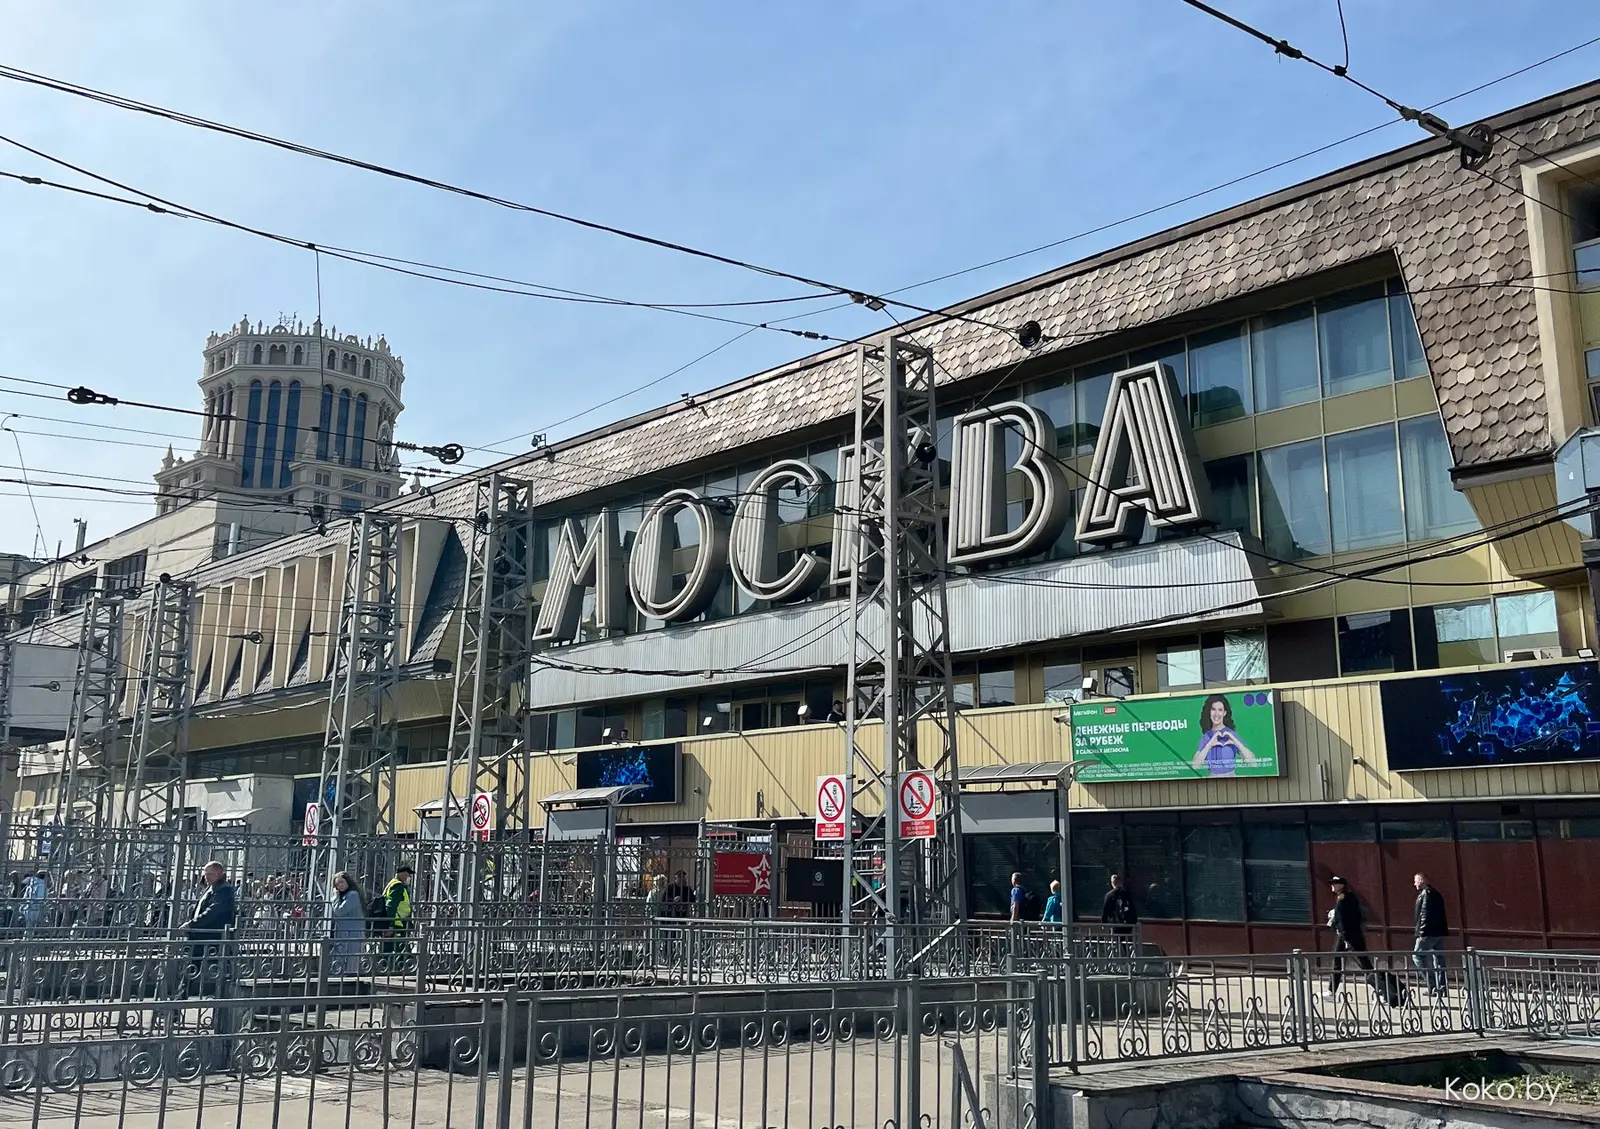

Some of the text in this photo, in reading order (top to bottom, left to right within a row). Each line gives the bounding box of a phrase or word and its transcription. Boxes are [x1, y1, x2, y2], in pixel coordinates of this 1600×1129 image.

[1075, 719, 1188, 737] ДЕНЕЖНЫЕ ПЕРЕВОДЫ
[1075, 735, 1124, 747] ЗА РУБЕЖ
